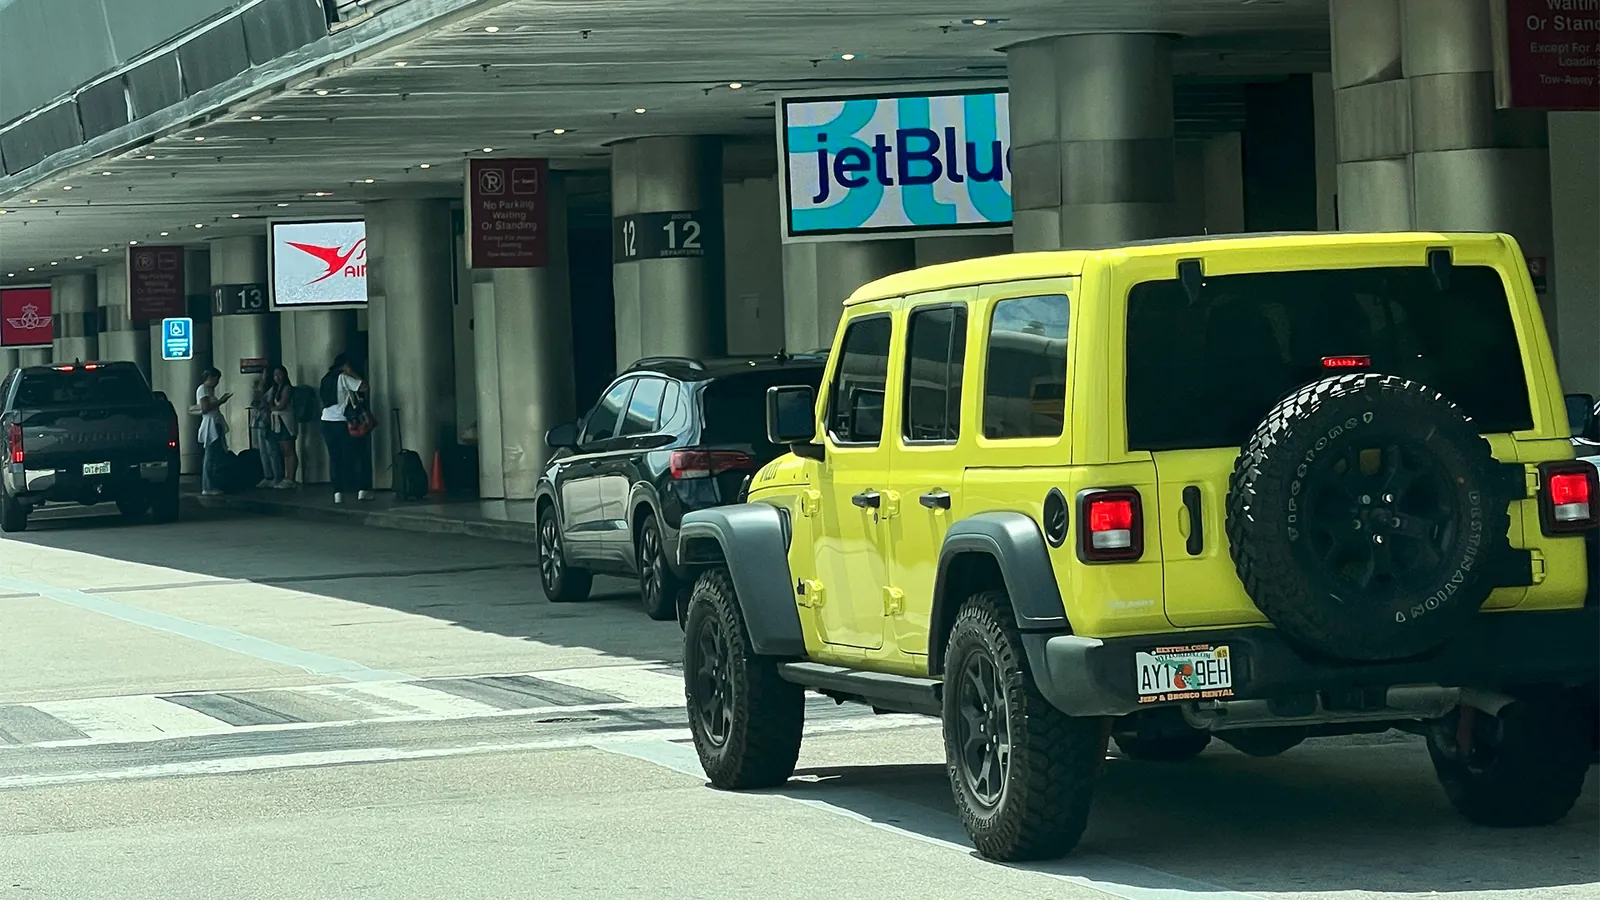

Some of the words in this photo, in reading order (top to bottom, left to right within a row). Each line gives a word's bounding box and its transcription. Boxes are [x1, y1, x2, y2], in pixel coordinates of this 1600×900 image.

[1546, 0, 1600, 10] Waitin
[1527, 15, 1547, 31] Or
[1530, 42, 1569, 54] Except
[1571, 42, 1590, 53] For
[1539, 73, 1594, 87] Tow-Away
[813, 127, 1012, 204] jetBlu
[483, 200, 497, 210] No
[499, 200, 534, 211] Parking
[492, 211, 526, 221] Waiting
[481, 221, 492, 231] Or
[495, 221, 537, 231] Standing
[623, 220, 637, 257] 12
[663, 220, 701, 249] 12
[237, 289, 262, 309] 13
[1410, 490, 1483, 619] DESTINATION
[1167, 692, 1200, 701] BRONCO
[1202, 688, 1235, 698] RENTAL
